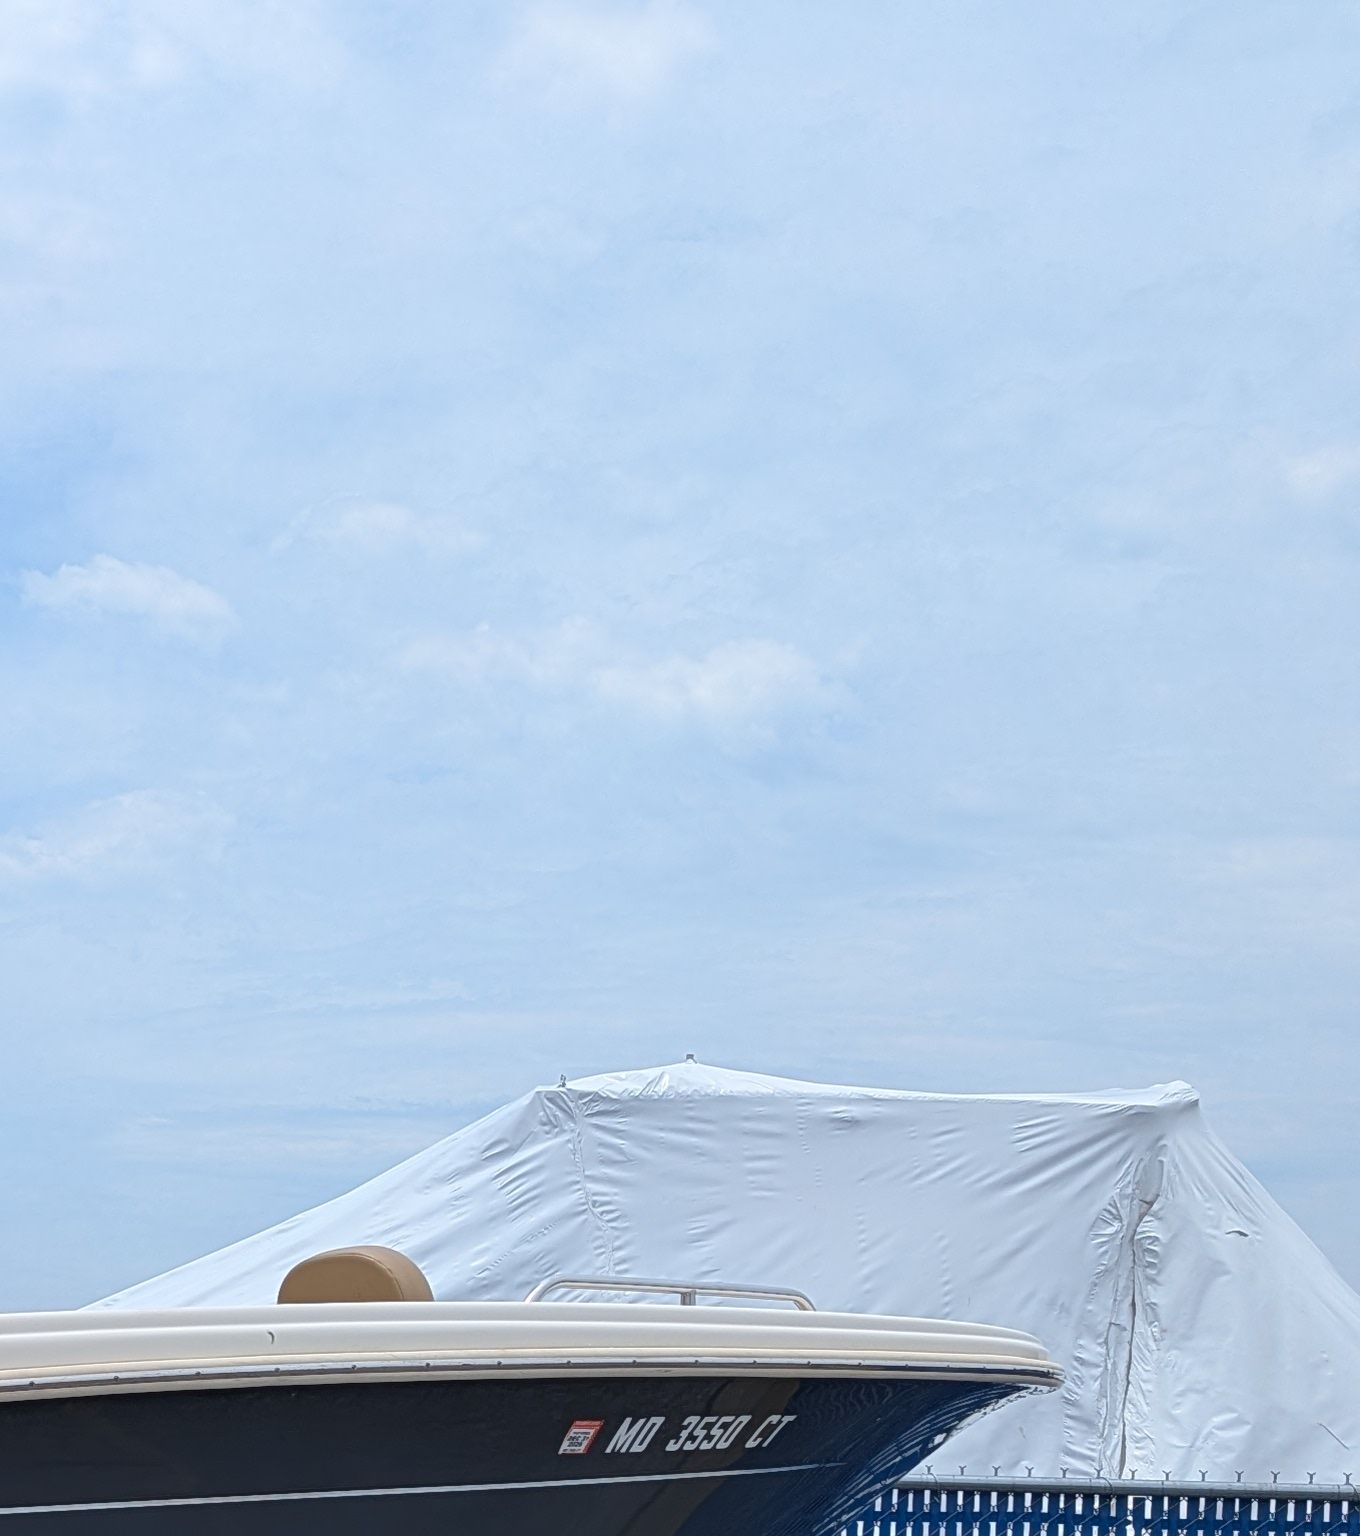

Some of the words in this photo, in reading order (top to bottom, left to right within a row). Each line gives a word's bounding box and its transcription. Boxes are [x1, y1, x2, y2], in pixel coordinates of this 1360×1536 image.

[605, 1416, 666, 1454] MD
[665, 1415, 753, 1452] 3550
[744, 1414, 798, 1448] CT
